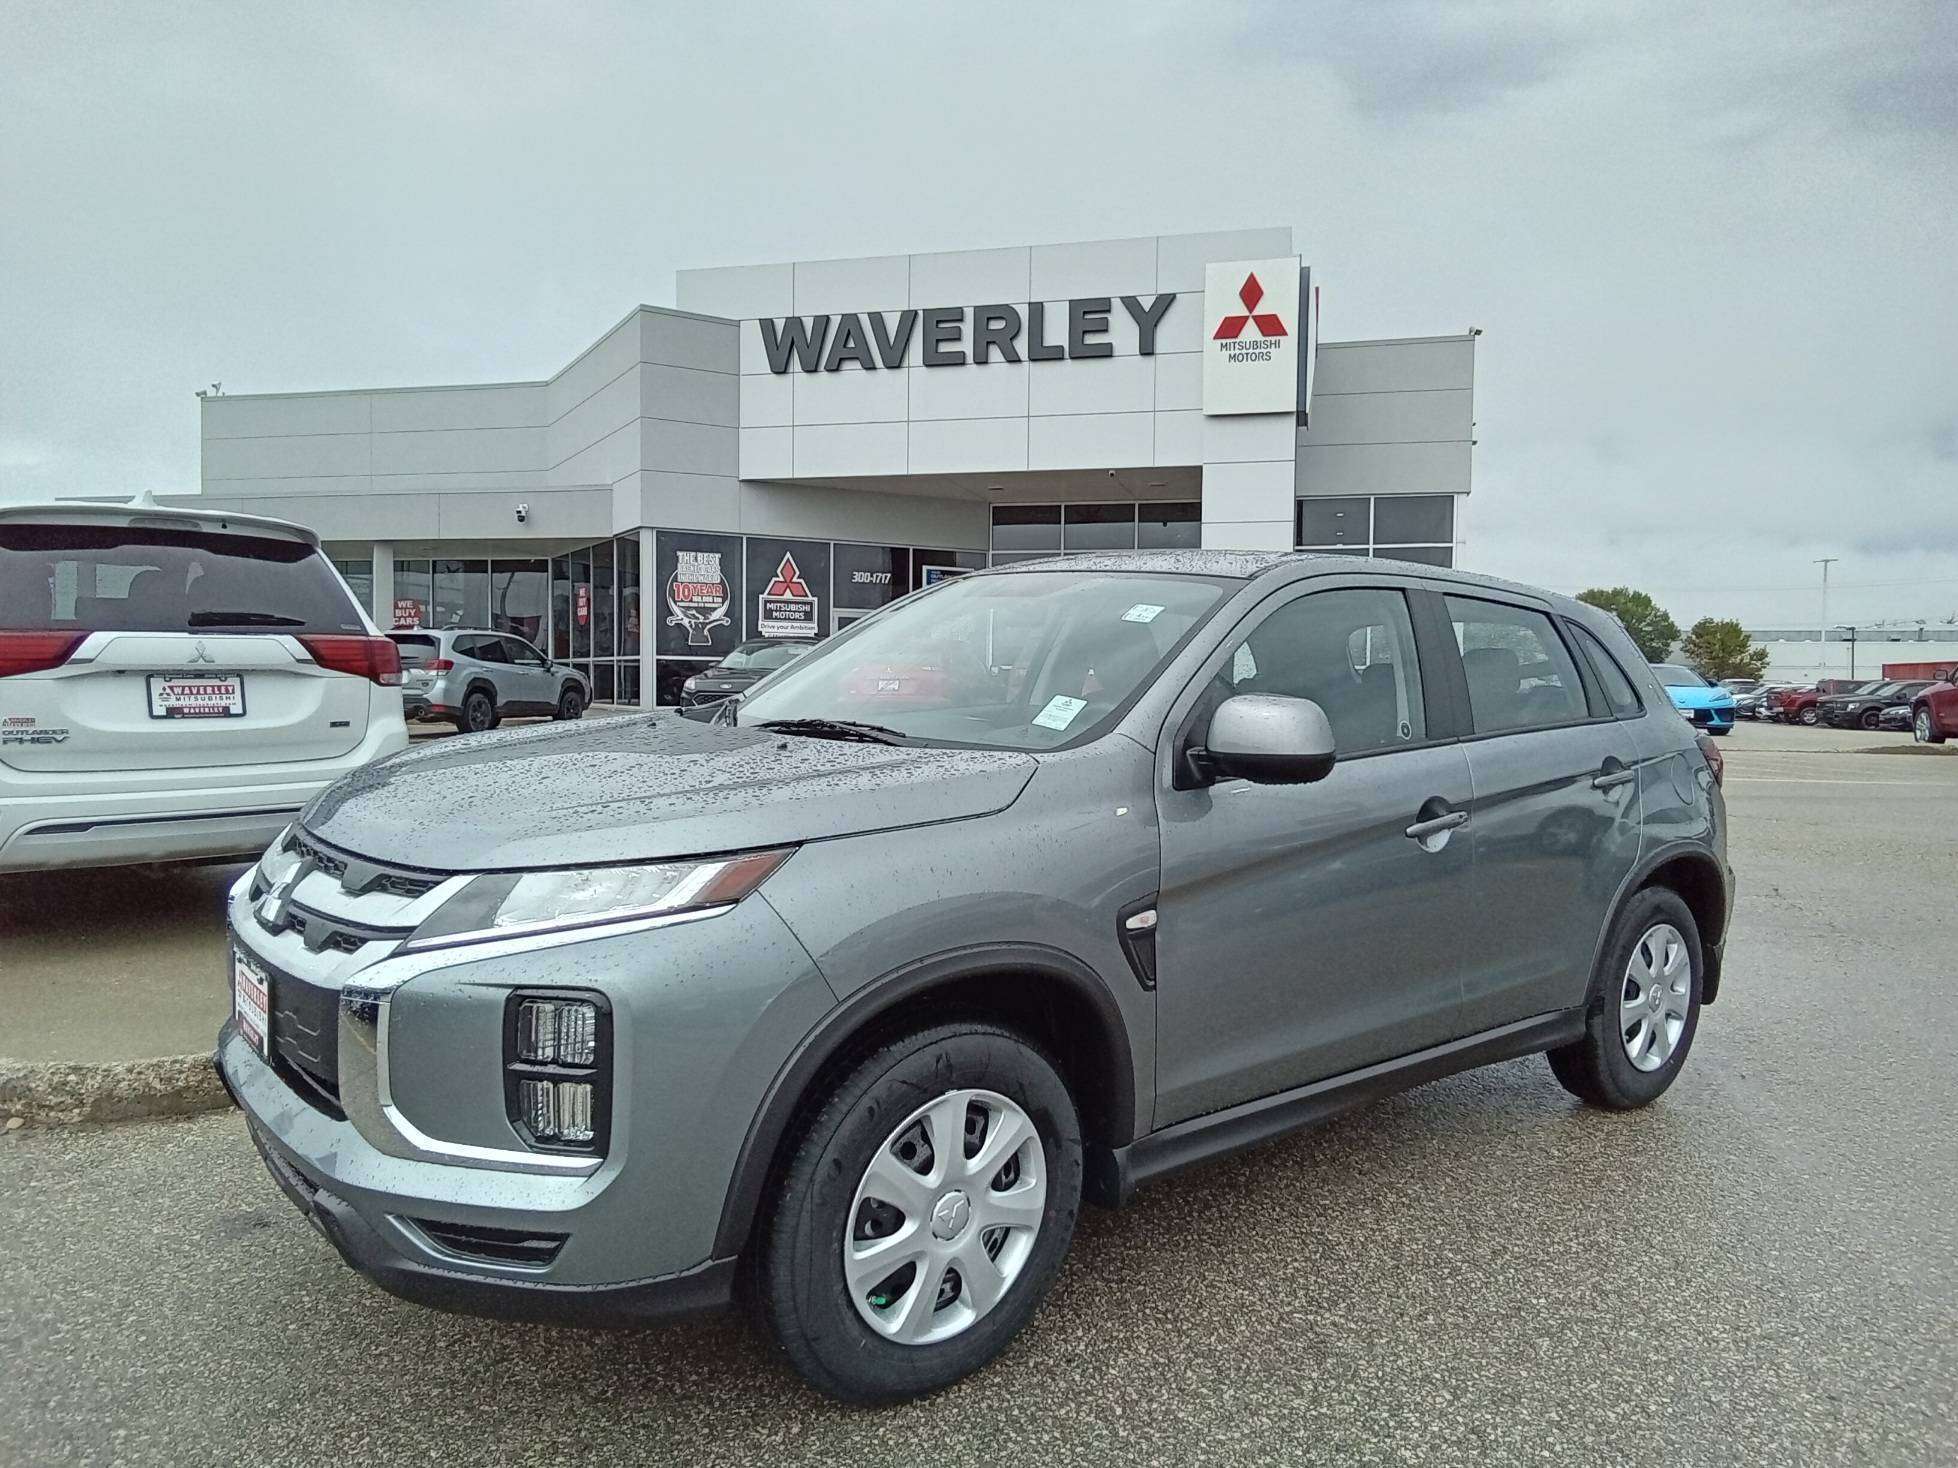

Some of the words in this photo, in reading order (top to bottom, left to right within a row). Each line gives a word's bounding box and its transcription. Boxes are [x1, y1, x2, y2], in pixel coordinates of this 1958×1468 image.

[759, 293, 1176, 374] WAVERLEY
[1220, 339, 1281, 352] MITSUBISHI
[1228, 351, 1272, 363] MOTORS
[677, 551, 696, 564] THE
[697, 552, 721, 565] BEST
[674, 582, 692, 601] 10
[691, 583, 723, 597] YEAR
[397, 600, 414, 608] WE
[766, 602, 811, 612] MITSUBISHI
[395, 608, 416, 617] BUY
[772, 611, 805, 620] MOTORS
[393, 617, 420, 625] CARS
[173, 686, 234, 694] WAVERLEY
